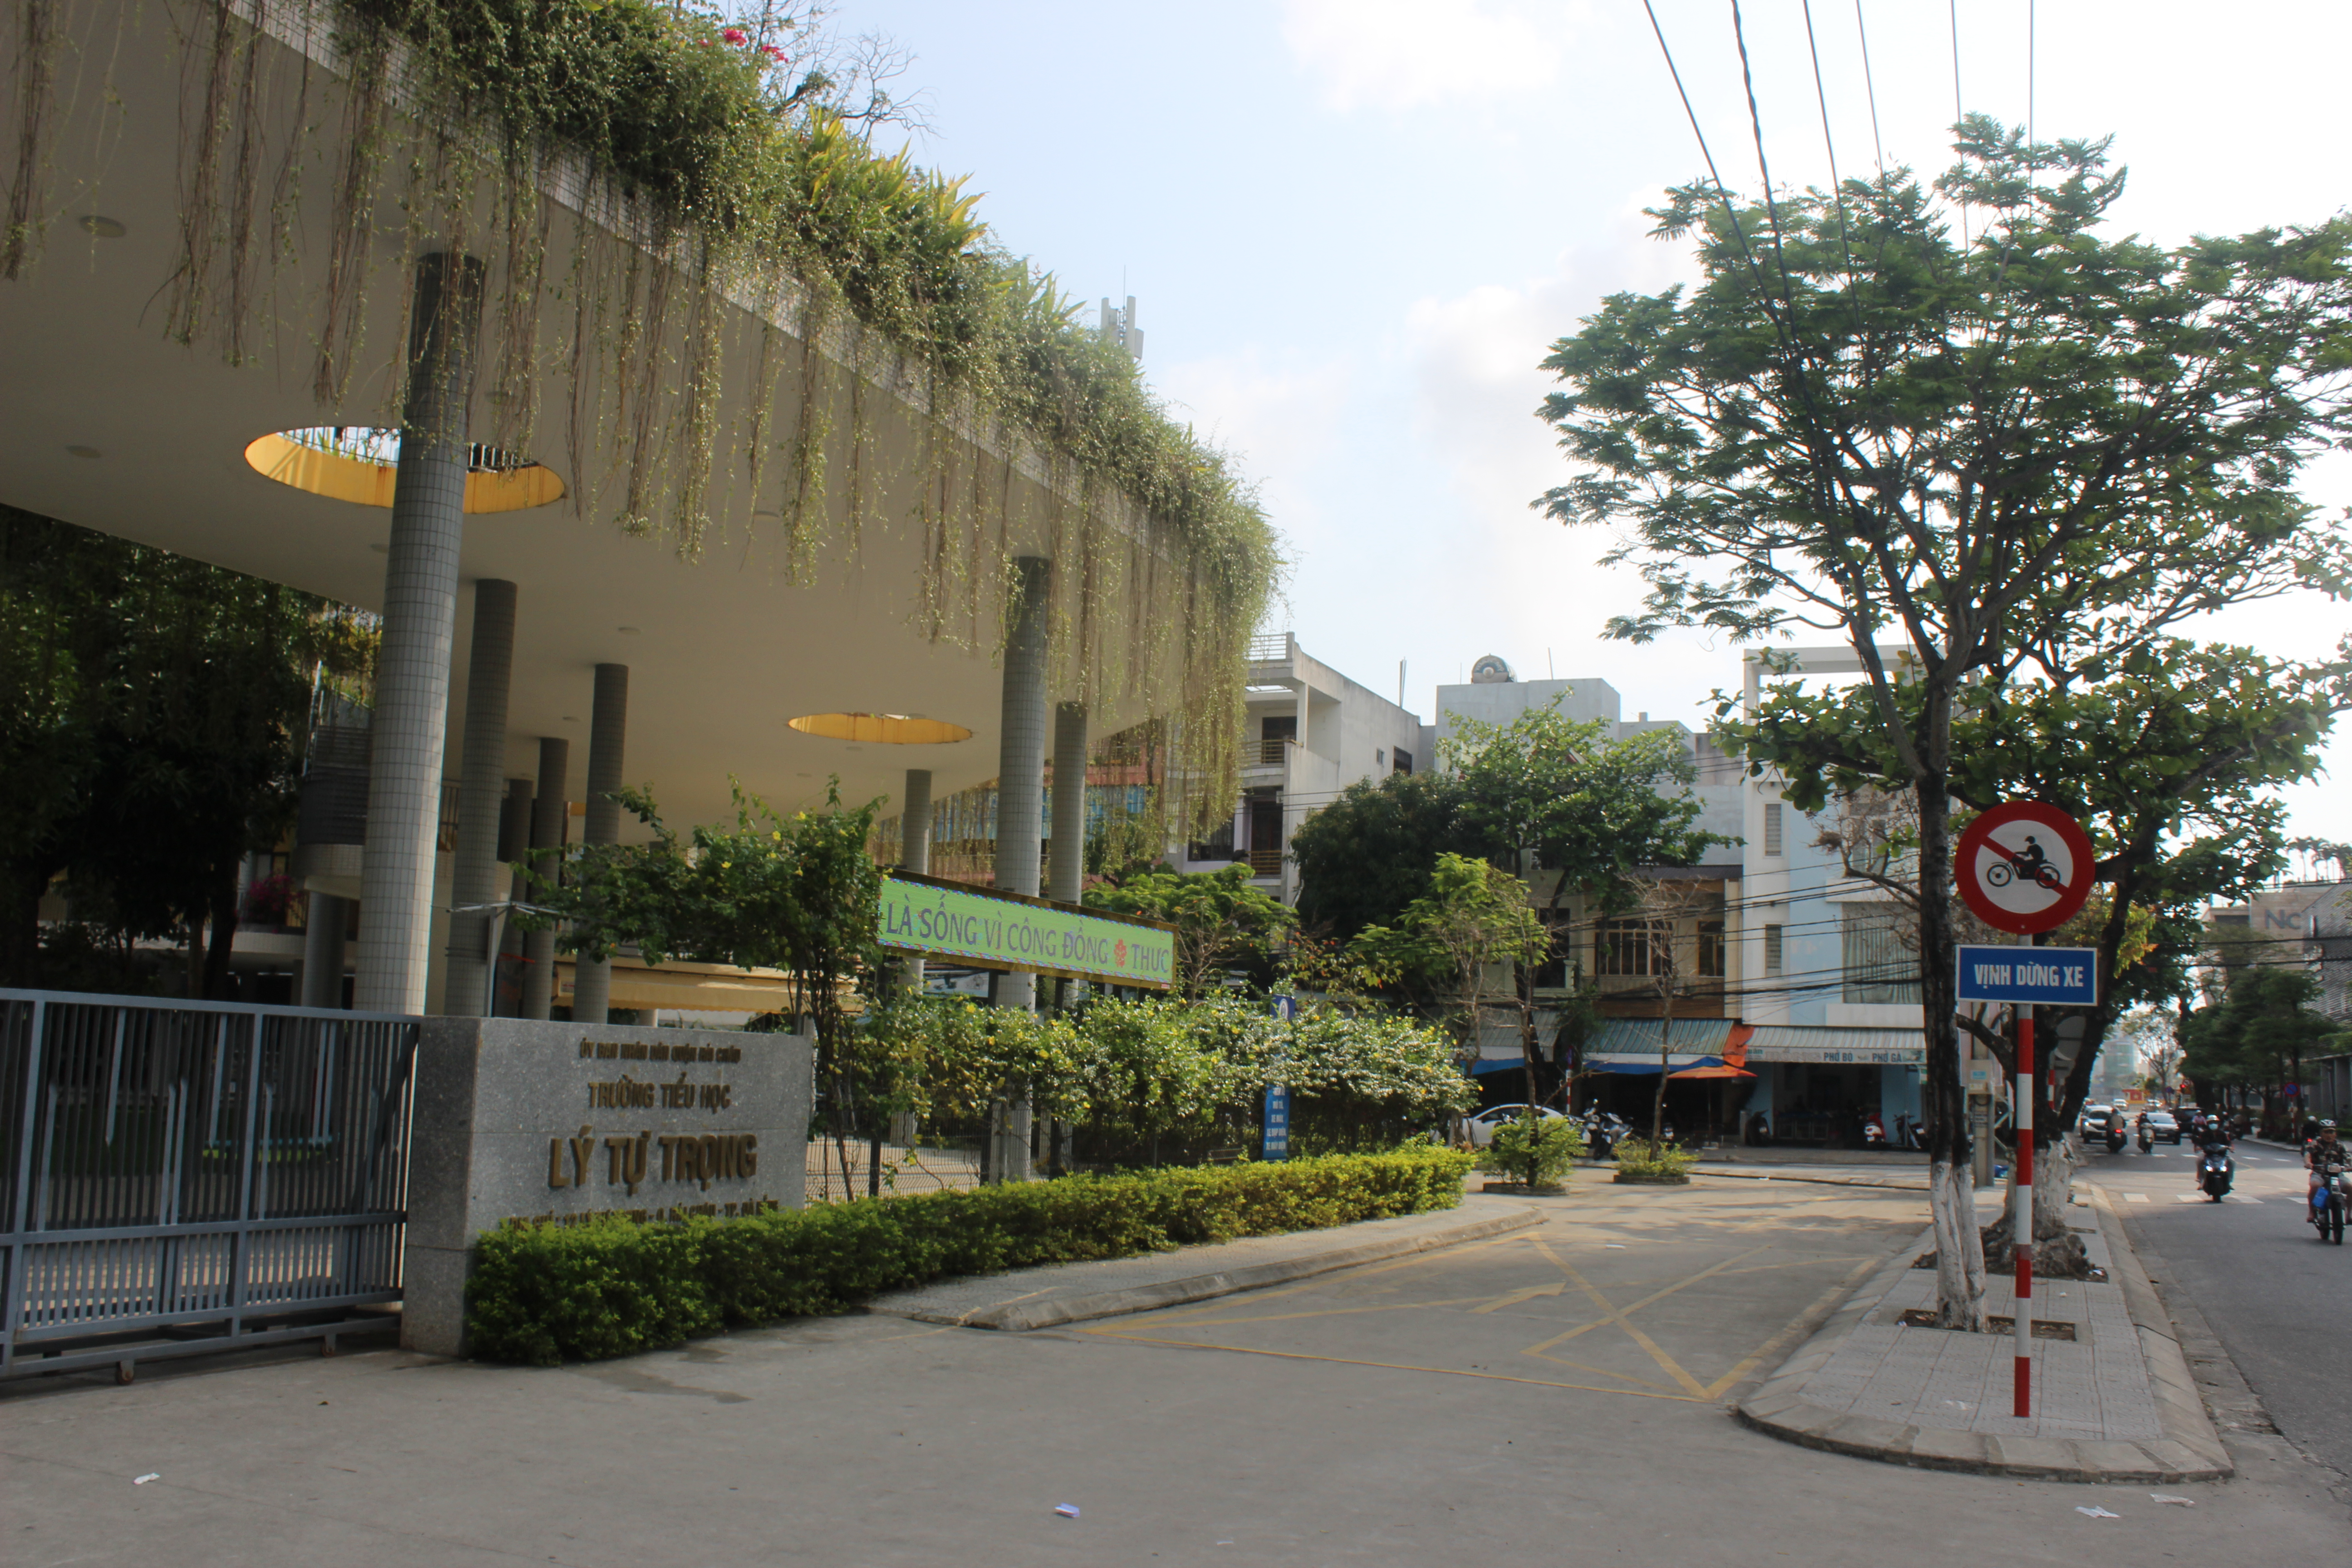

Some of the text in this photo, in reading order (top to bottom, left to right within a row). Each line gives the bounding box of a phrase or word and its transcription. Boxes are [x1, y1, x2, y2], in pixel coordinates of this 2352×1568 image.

[887, 893, 913, 936] LÀ
[920, 893, 977, 945] SỐNG
[984, 910, 1002, 950] VÌ
[1062, 919, 1108, 965] ĐỒNG
[1974, 960, 2084, 989] VỊNH DỪNG XE
[588, 1074, 655, 1109] TRƯỜNG
[700, 1084, 731, 1114] HỌC
[548, 1125, 758, 1196] LÝ TỰ TRỌNG
